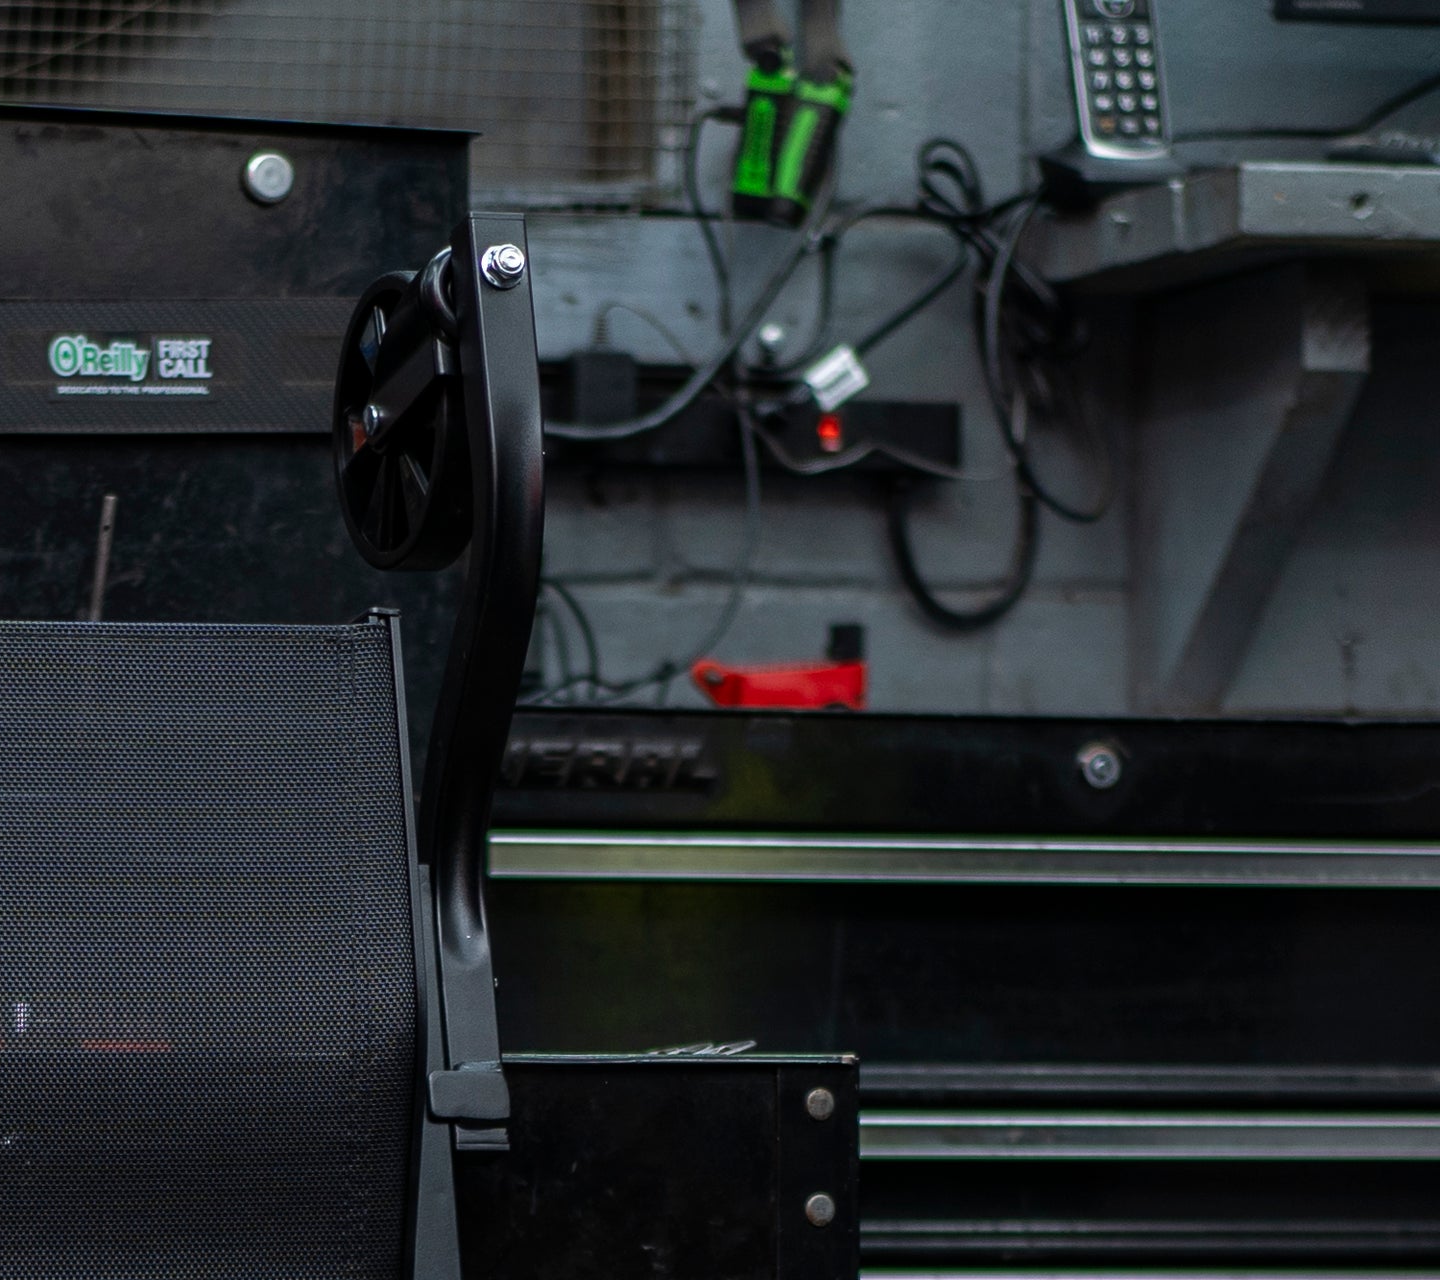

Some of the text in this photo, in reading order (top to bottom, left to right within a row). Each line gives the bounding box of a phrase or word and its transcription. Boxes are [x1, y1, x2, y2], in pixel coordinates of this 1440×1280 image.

[49, 334, 152, 382] O'Reilly
[158, 340, 212, 358] FIRST
[159, 359, 213, 378] CALL
